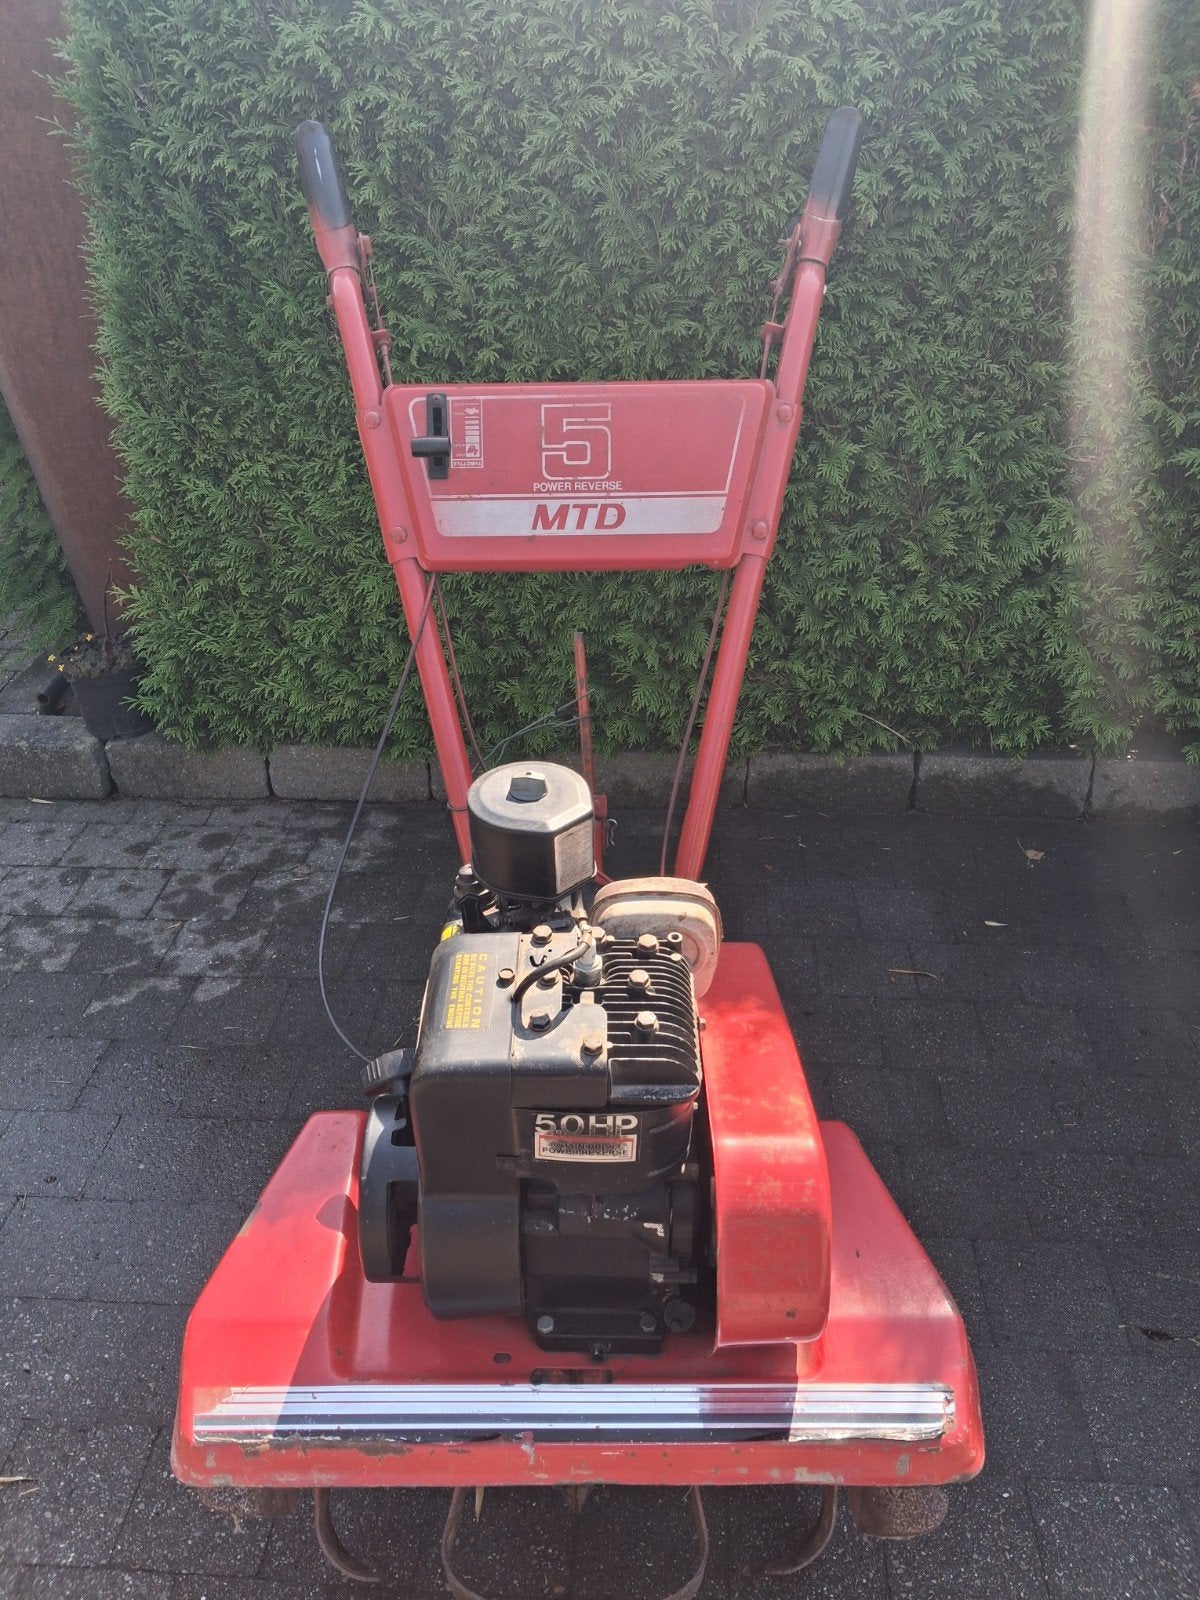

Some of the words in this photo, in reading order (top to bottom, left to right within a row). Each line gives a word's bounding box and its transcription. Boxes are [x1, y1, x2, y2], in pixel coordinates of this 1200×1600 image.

[541, 403, 611, 480] 5
[533, 482, 572, 492] POWER
[574, 481, 622, 491] REVERSE
[531, 503, 626, 530] MTD
[466, 980, 474, 992] THE
[471, 953, 487, 1029] CAUTION
[542, 1146, 580, 1155] POWER
[581, 1148, 629, 1156] REVERSE
